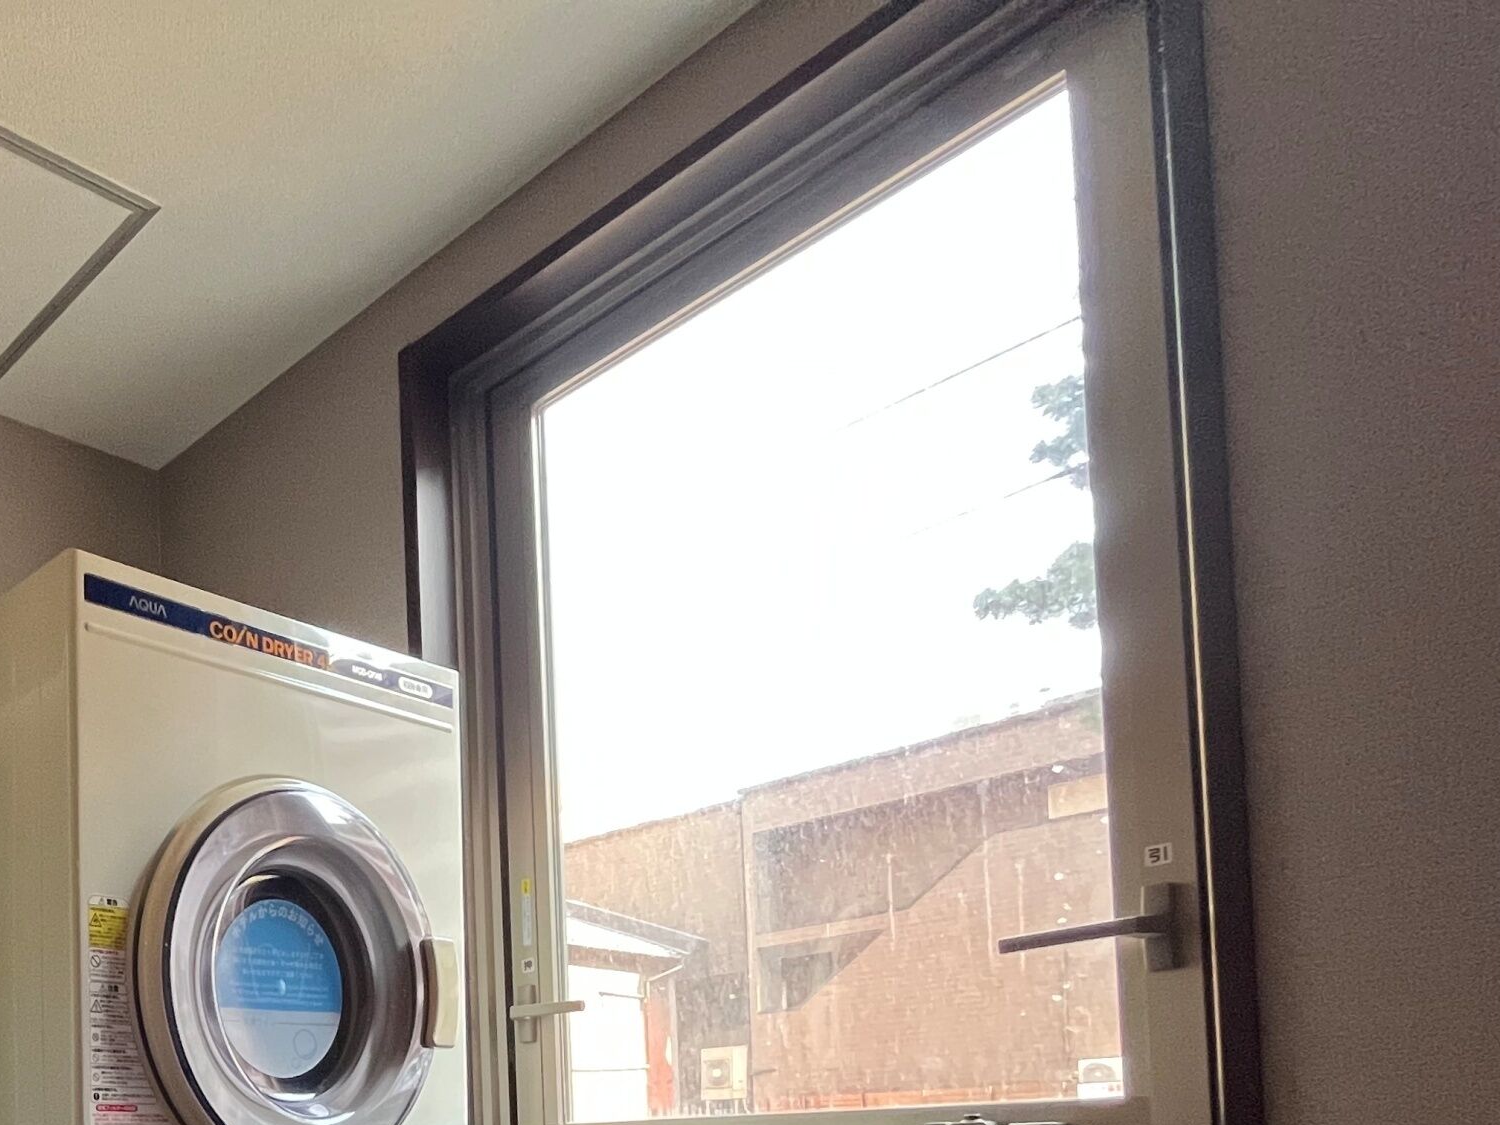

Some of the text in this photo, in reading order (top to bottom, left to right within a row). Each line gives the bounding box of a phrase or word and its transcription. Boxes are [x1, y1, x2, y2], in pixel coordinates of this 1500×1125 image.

[129, 595, 168, 619] AQUA
[209, 620, 259, 650] COIN
[262, 636, 314, 666] DRYER
